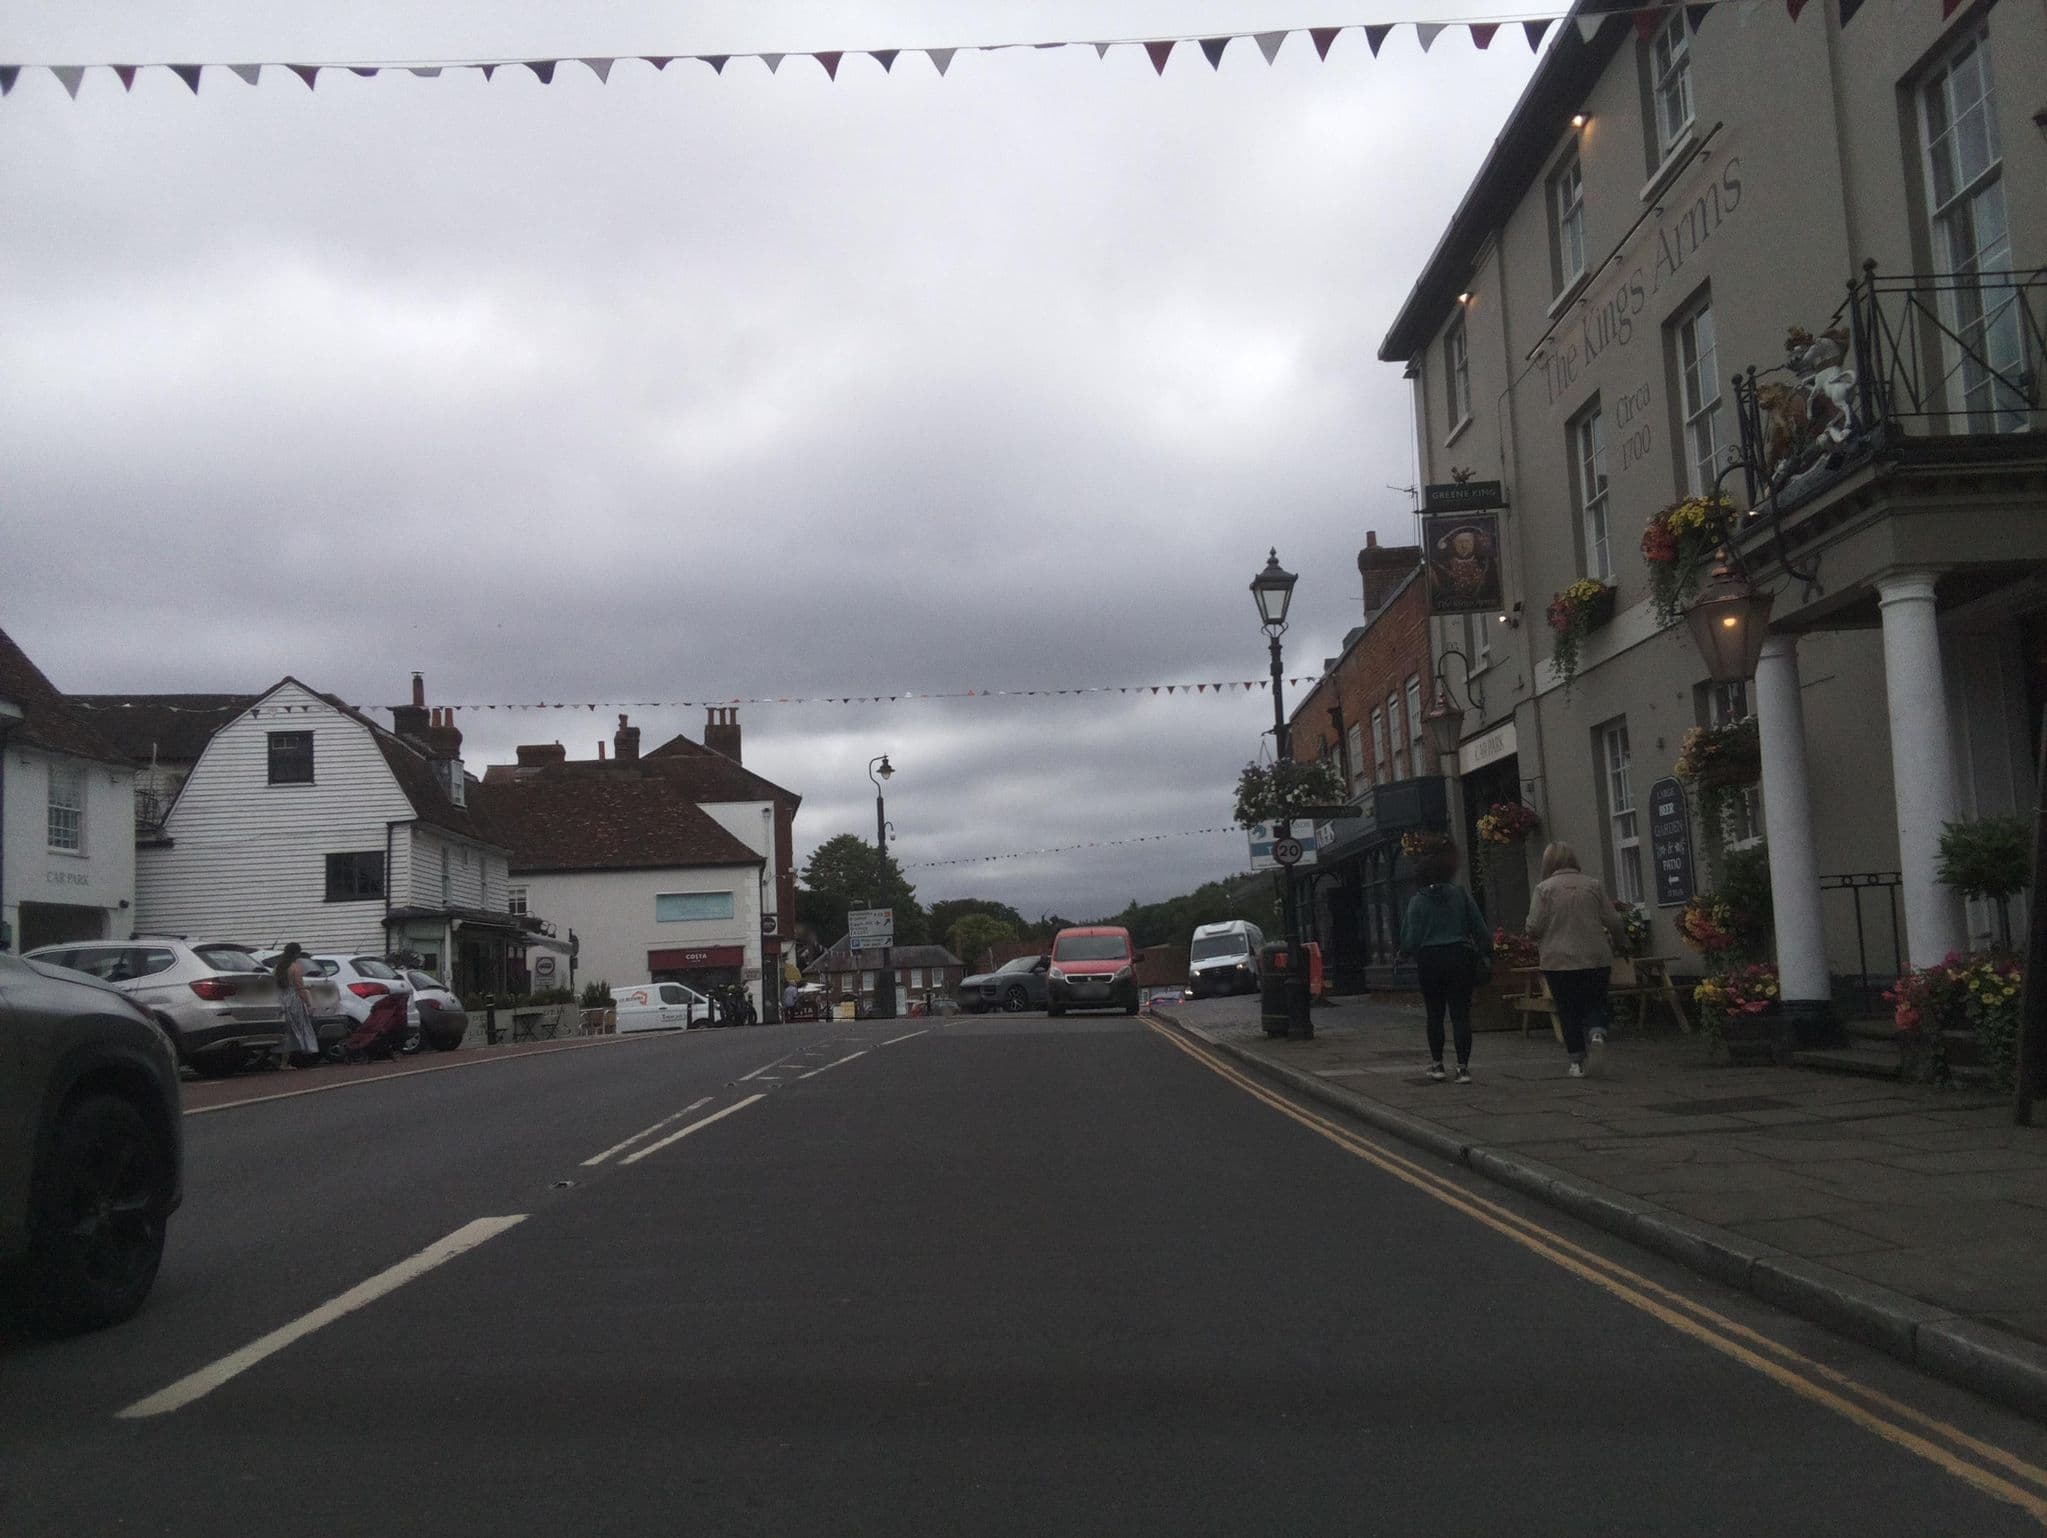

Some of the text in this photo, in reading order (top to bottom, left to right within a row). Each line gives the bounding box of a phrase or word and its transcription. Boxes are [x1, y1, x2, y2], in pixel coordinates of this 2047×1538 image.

[1538, 155, 1745, 406] The Kings Arms
[1615, 380, 1652, 430] Circa
[1621, 422, 1653, 473] 1700
[1279, 845, 1299, 857] 20
[1662, 857, 1682, 872] PATIO
[47, 871, 89, 886] CAR PARK
